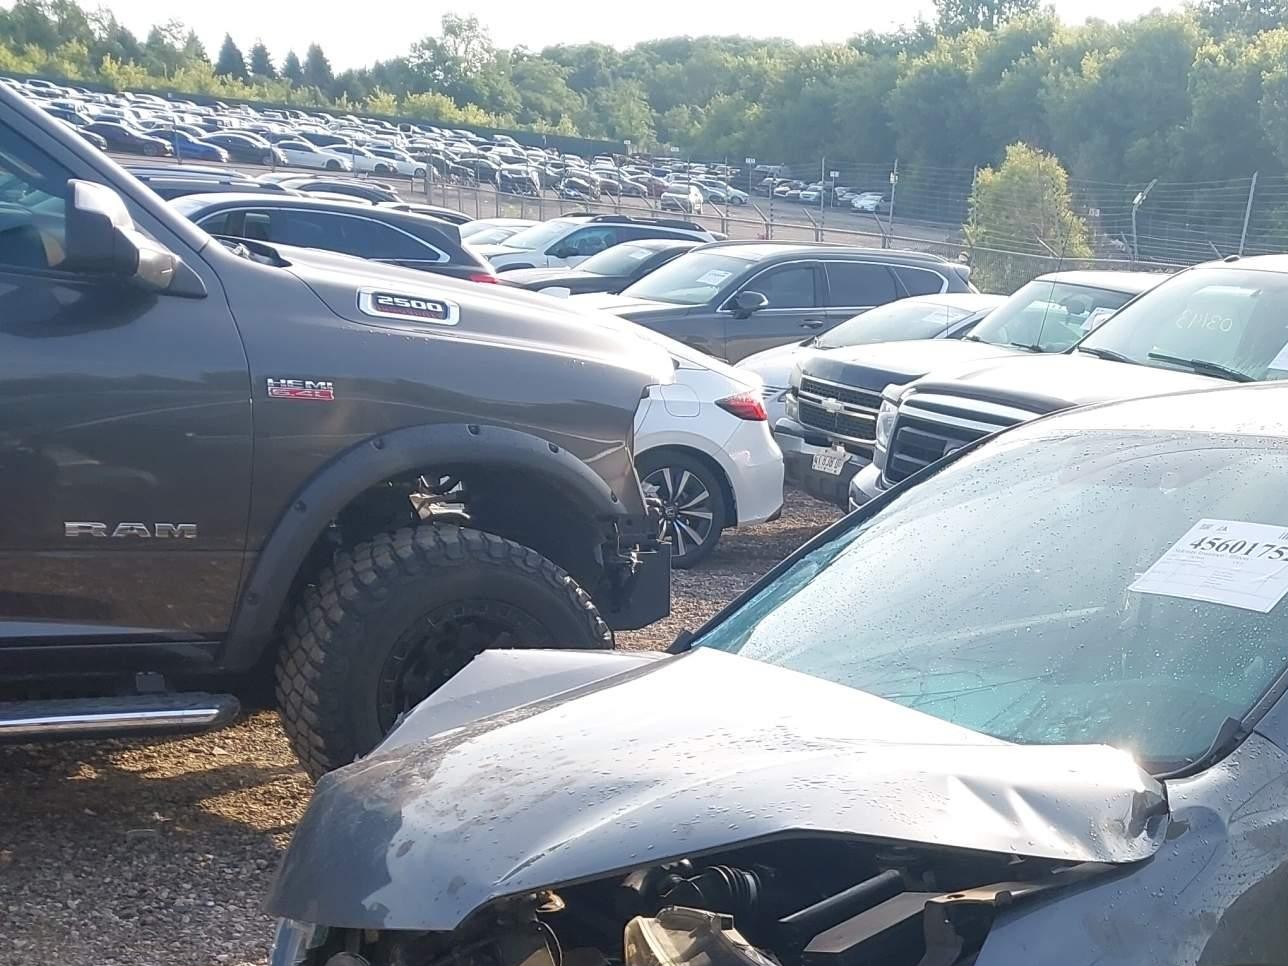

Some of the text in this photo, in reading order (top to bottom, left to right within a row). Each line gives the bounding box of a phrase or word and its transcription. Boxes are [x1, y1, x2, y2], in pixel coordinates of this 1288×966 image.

[376, 295, 443, 312] 2500
[266, 378, 334, 390] HEMI
[64, 521, 197, 538] RAM
